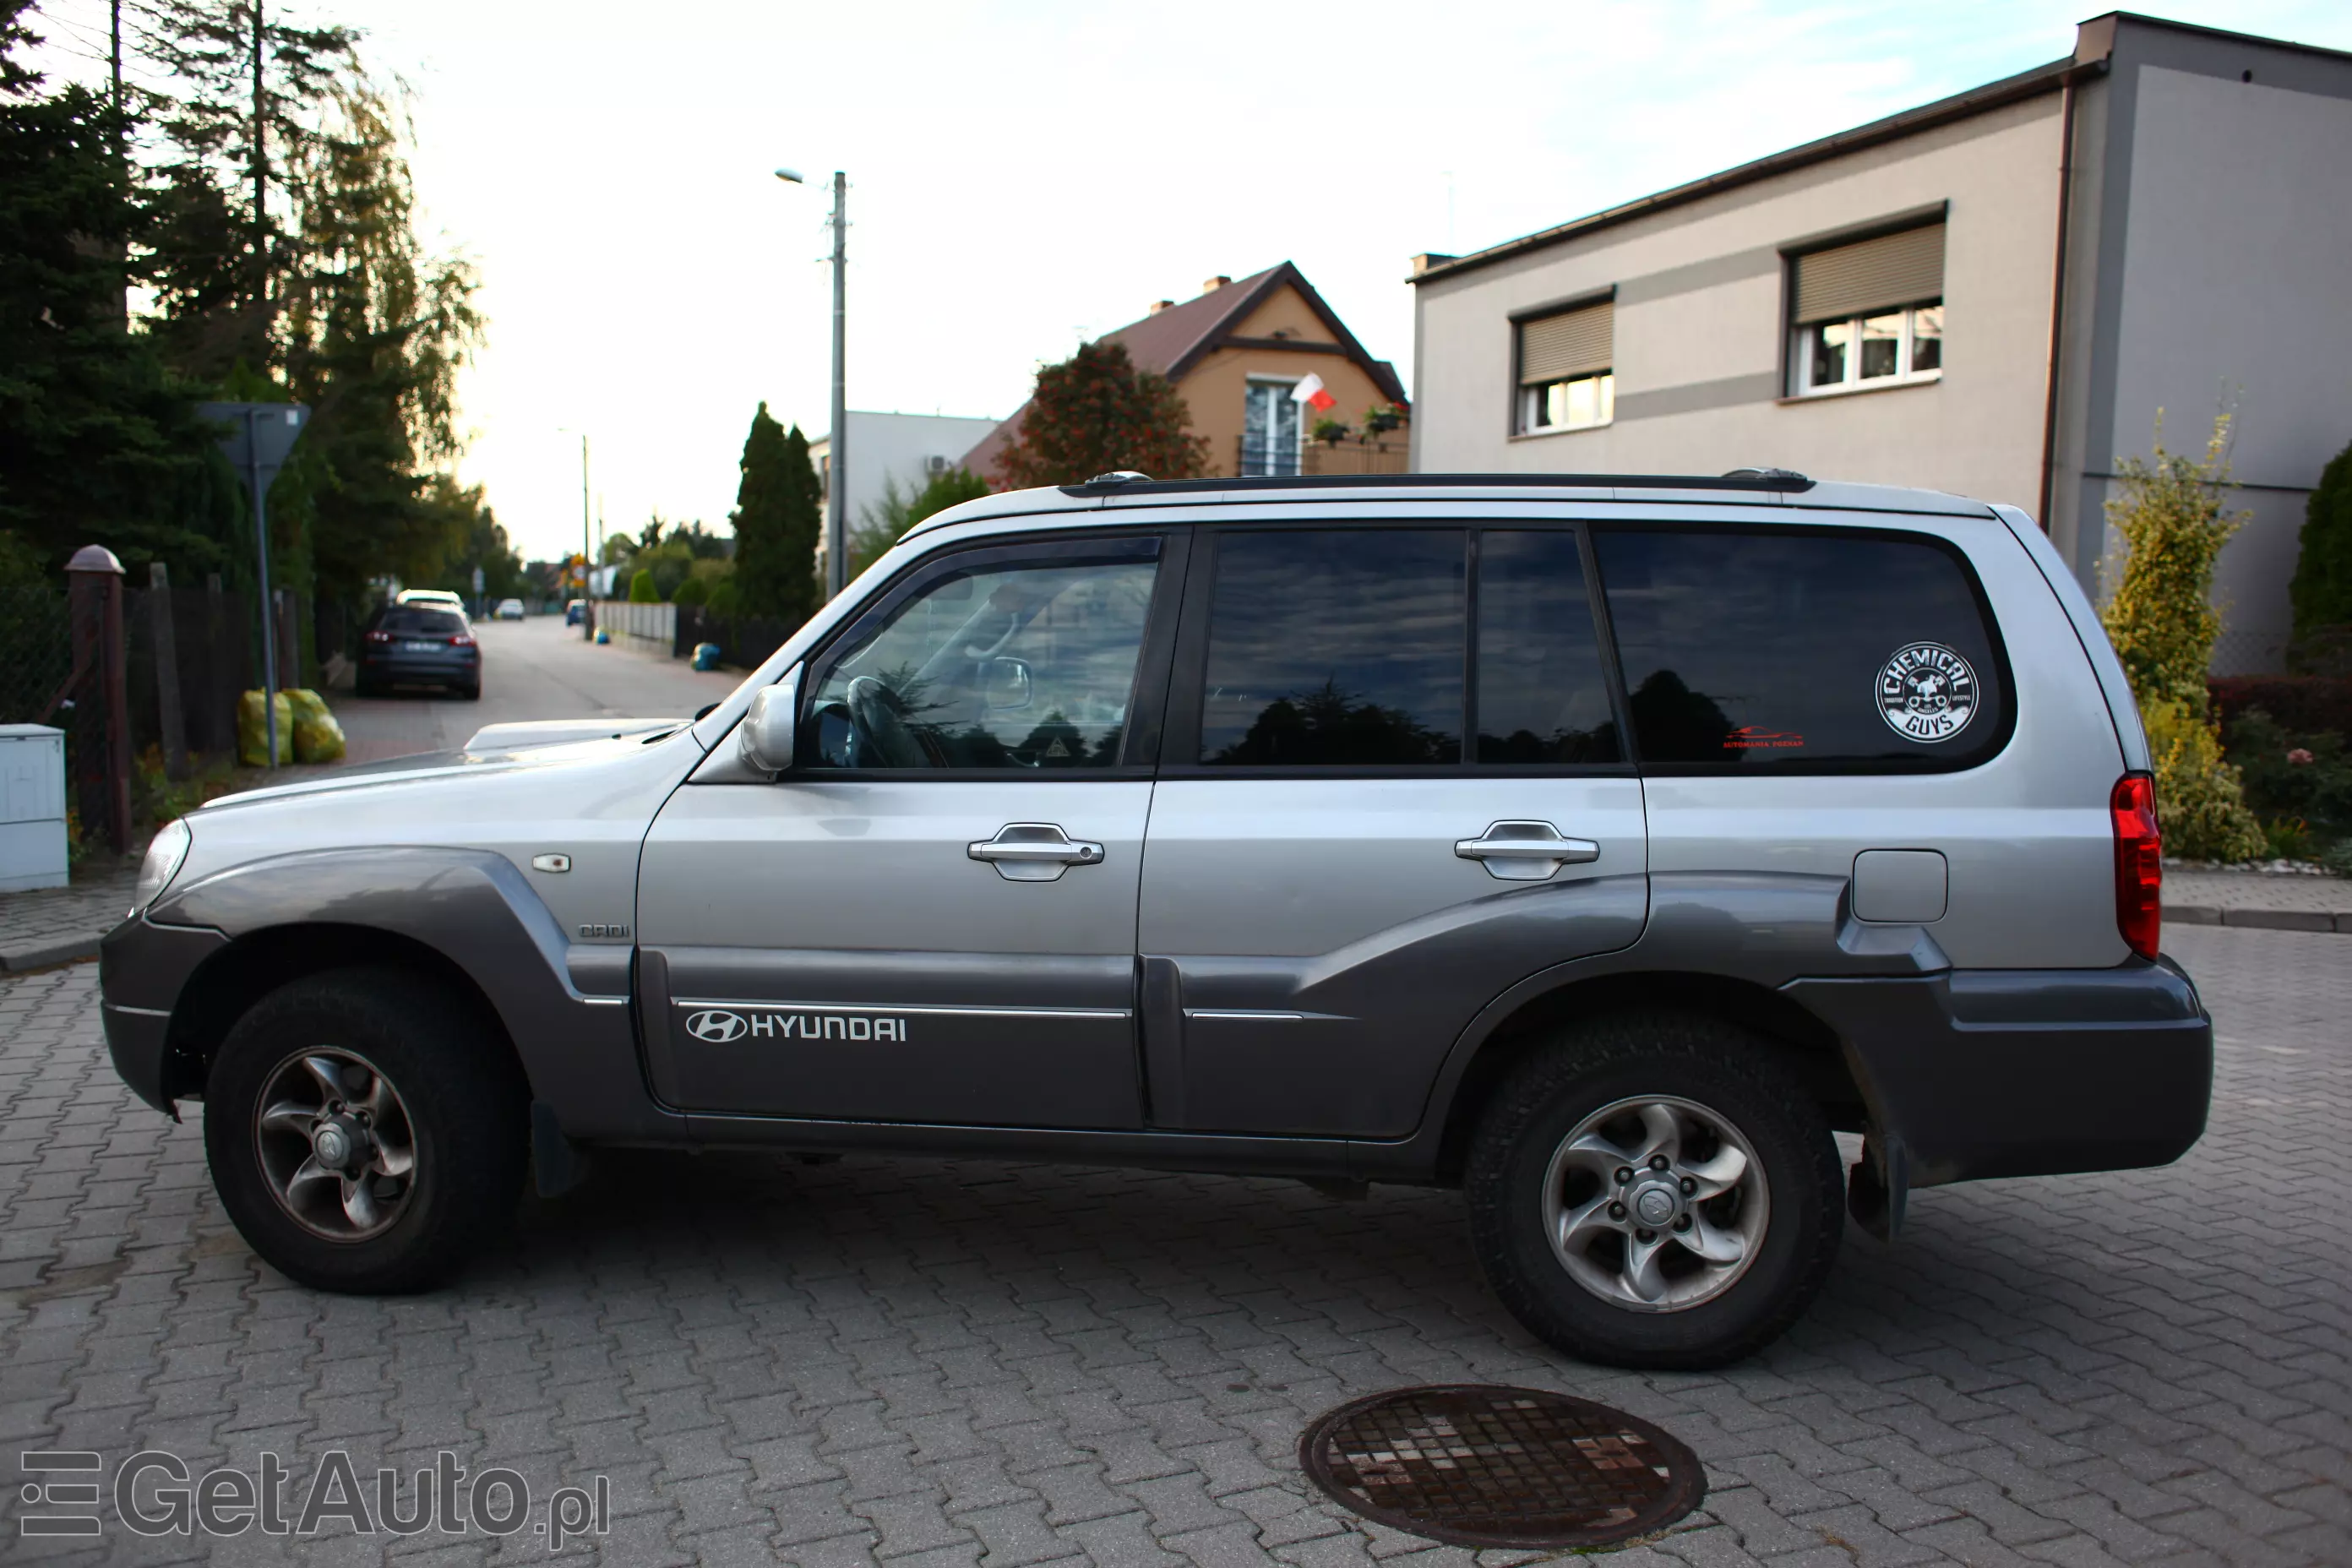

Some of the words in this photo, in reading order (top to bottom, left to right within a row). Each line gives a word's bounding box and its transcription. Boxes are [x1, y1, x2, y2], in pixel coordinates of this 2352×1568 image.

[1883, 648, 1970, 694] CHEMICAL
[1905, 715, 1954, 735] GUYS
[751, 1014, 906, 1042] HYUNDAI
